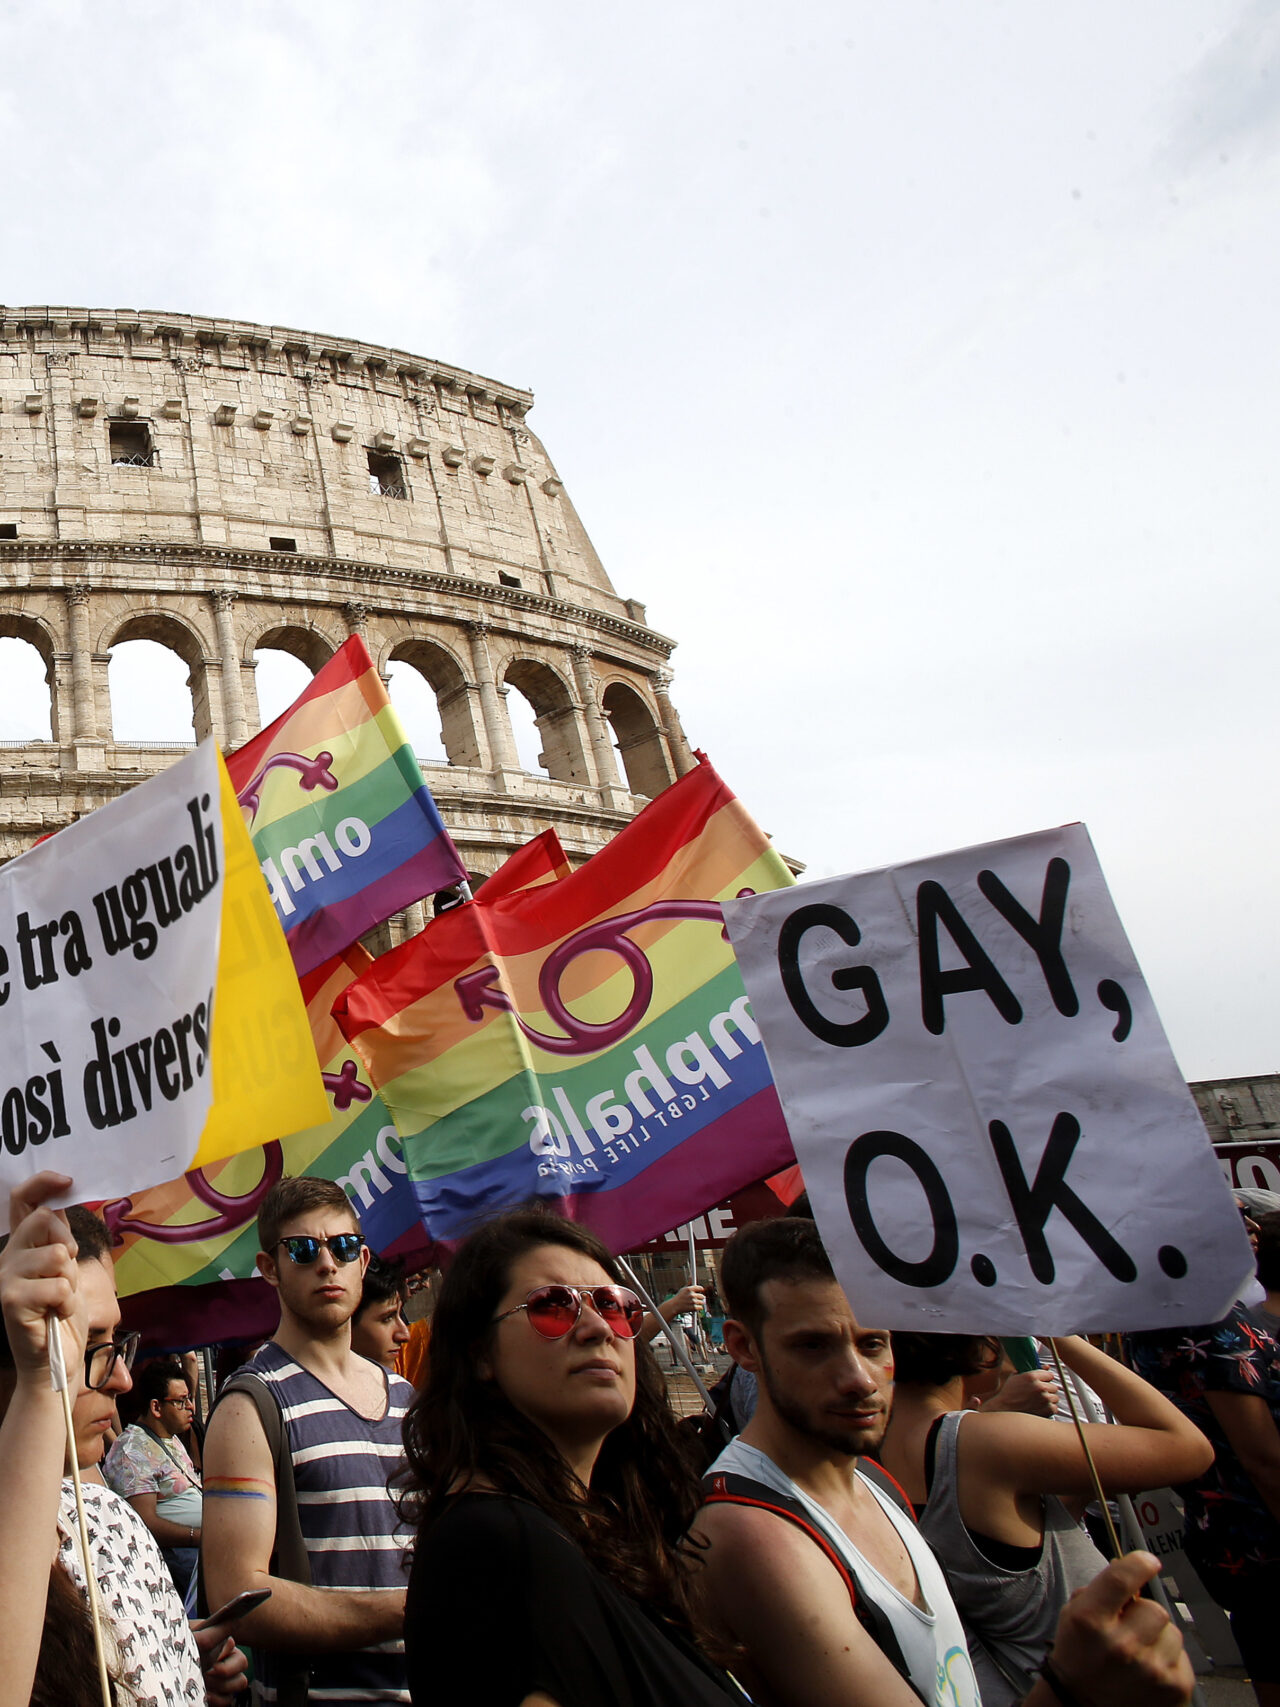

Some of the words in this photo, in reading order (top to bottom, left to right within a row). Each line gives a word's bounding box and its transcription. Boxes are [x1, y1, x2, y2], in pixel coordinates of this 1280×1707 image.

[17, 910, 93, 991] tra
[92, 793, 220, 961] uguali
[777, 856, 1133, 1049] GAY,
[83, 986, 215, 1131] divers
[844, 1111, 1189, 1289] O.K.
